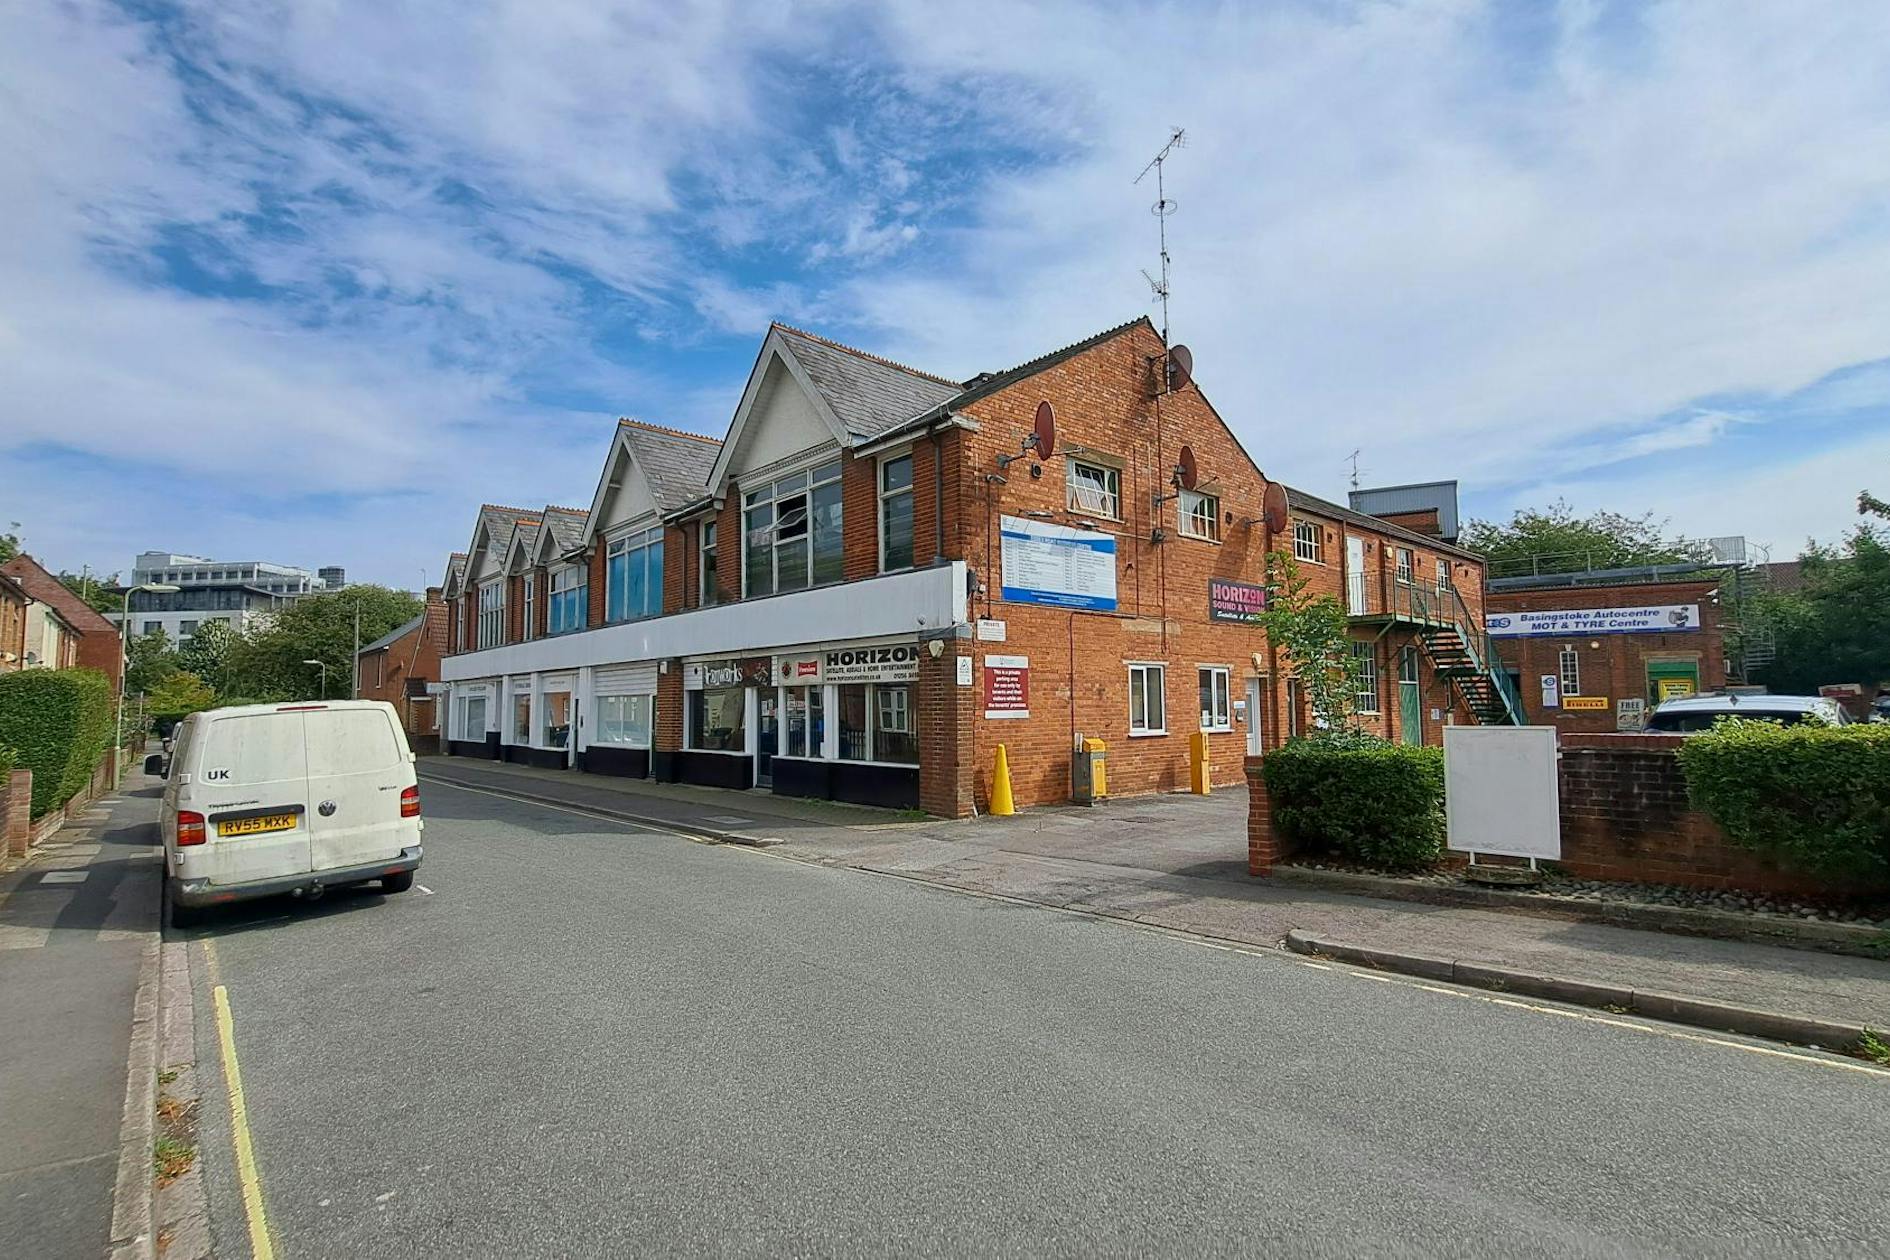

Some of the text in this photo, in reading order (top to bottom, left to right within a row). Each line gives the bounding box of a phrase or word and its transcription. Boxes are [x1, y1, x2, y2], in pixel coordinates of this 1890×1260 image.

[1212, 583, 1265, 605] HORIZON
[1212, 600, 1236, 610] SOUND
[1237, 603, 1243, 611] &
[1520, 609, 1660, 622] Basingstoke Autocentre
[1531, 619, 1649, 630] MOT & TYRE Centre
[826, 646, 920, 666] HORIZON
[881, 664, 917, 672] ENTERTAINMENT
[208, 770, 229, 780] UK
[225, 815, 290, 833] RV55 MXK
